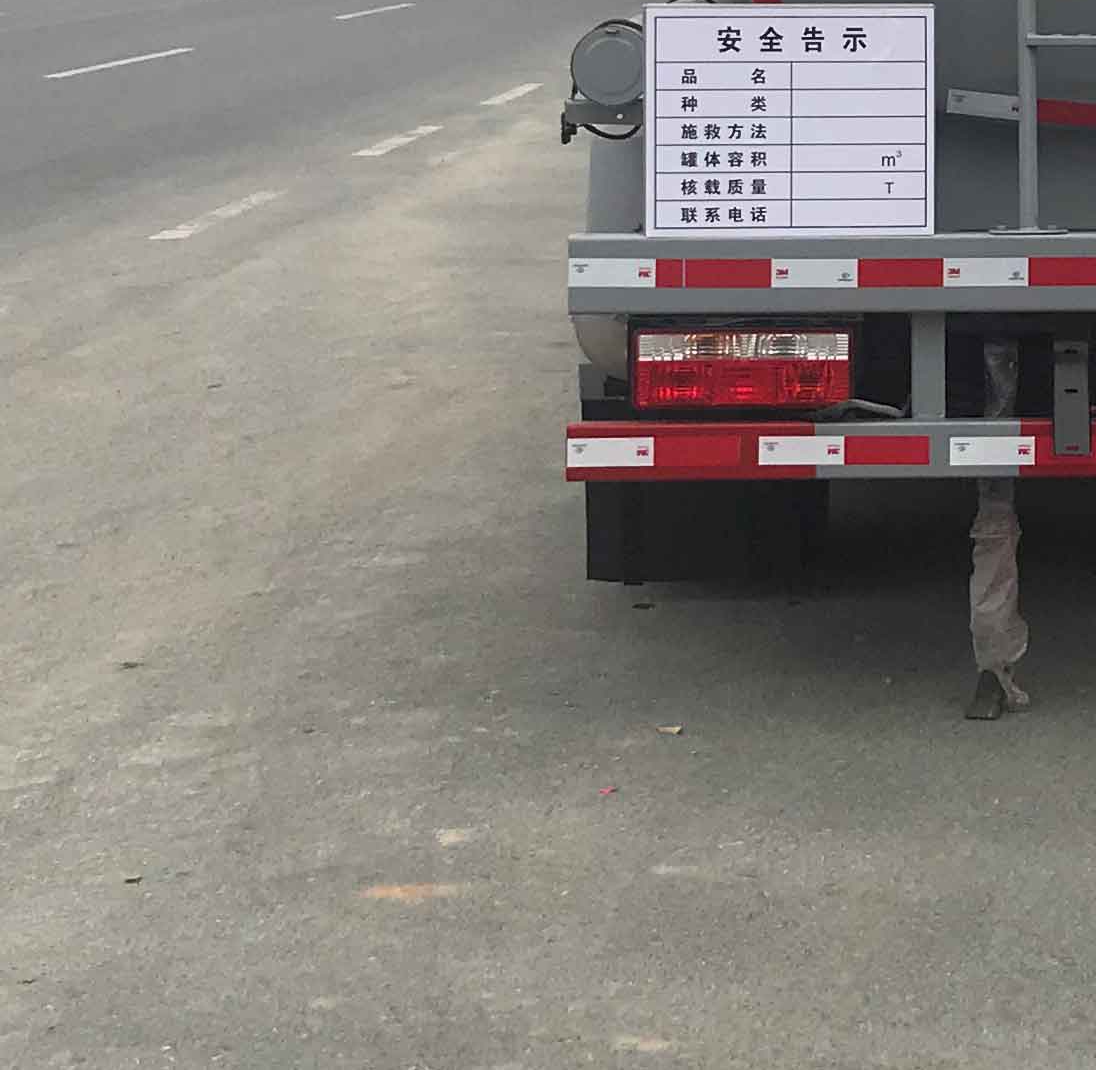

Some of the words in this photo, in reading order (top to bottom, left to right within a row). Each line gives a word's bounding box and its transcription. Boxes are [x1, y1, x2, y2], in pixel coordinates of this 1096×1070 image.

[717, 26, 867, 53] 安全告示
[681, 123, 767, 140] 施救方法
[681, 151, 767, 168] 罐体容积
[681, 179, 767, 195] 核载质量
[885, 182, 895, 194] T
[681, 207, 767, 223] 联系电话
